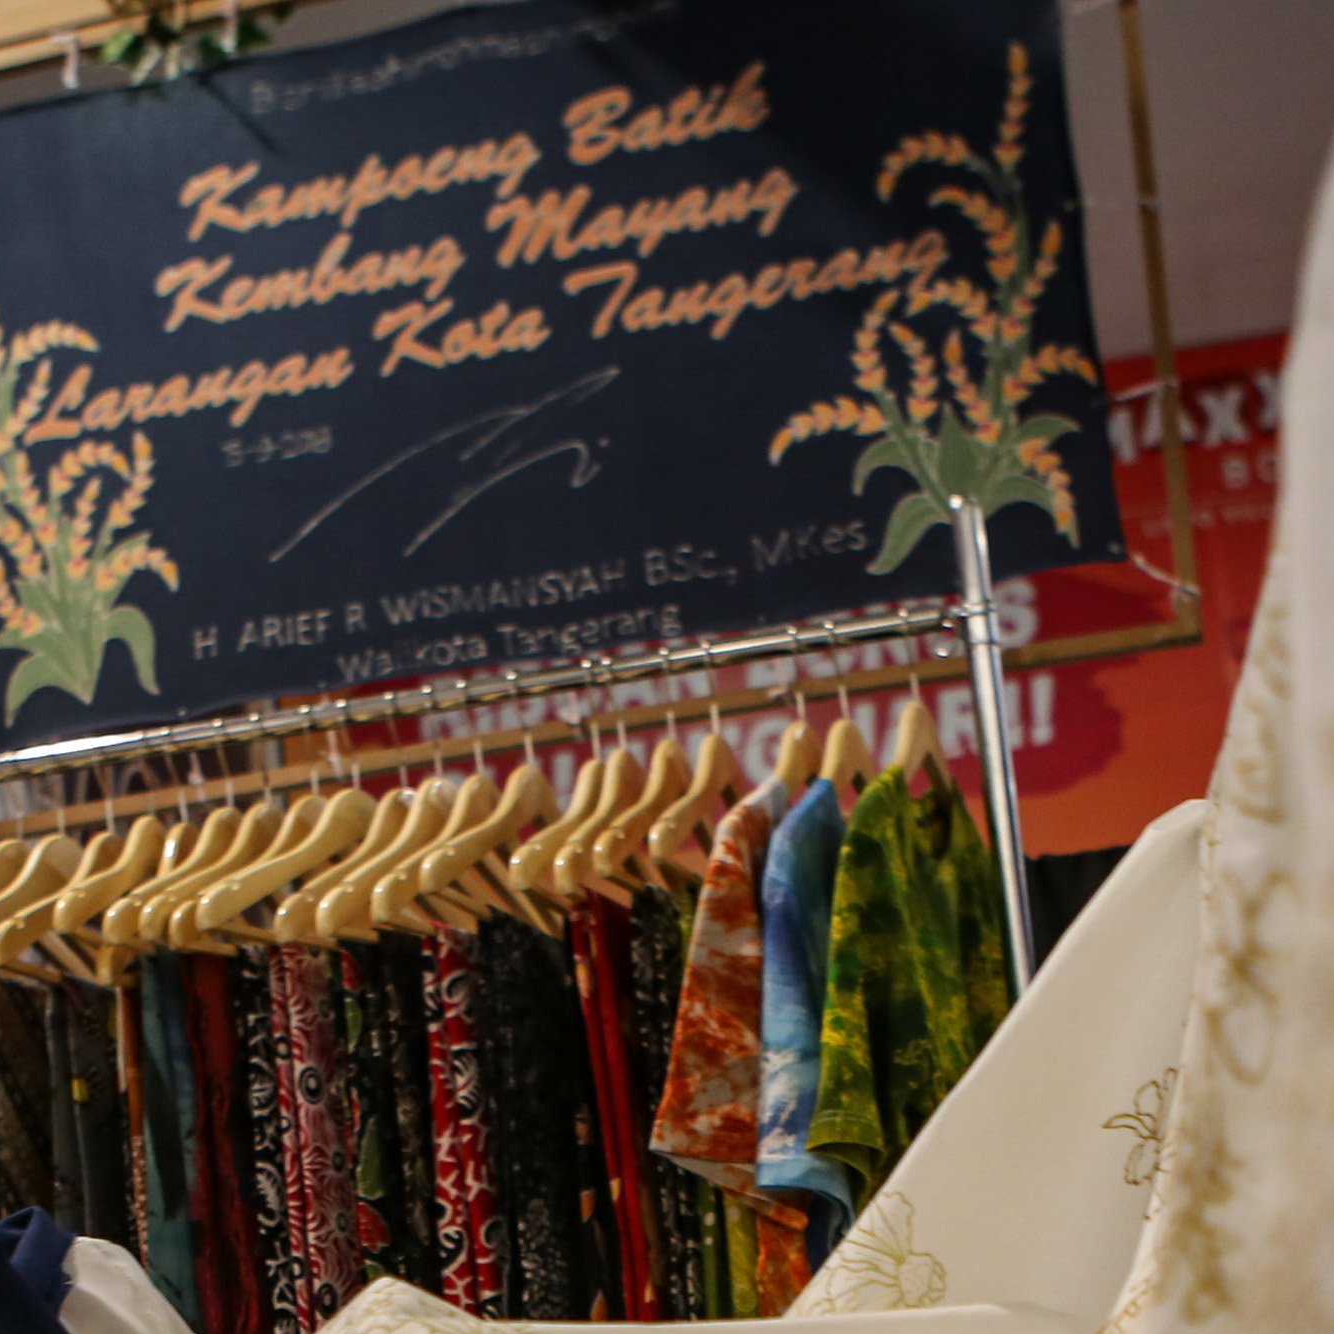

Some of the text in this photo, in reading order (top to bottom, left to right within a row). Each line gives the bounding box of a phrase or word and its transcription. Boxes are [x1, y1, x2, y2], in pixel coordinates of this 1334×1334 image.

[178, 130, 543, 243] Kampoeng
[561, 60, 769, 167] Batik
[155, 166, 799, 332] Kembang Mayang
[22, 229, 948, 445] Larangan Kota Tangerang
[193, 625, 220, 661] H
[237, 607, 331, 654] ARIEF
[345, 602, 366, 632] R
